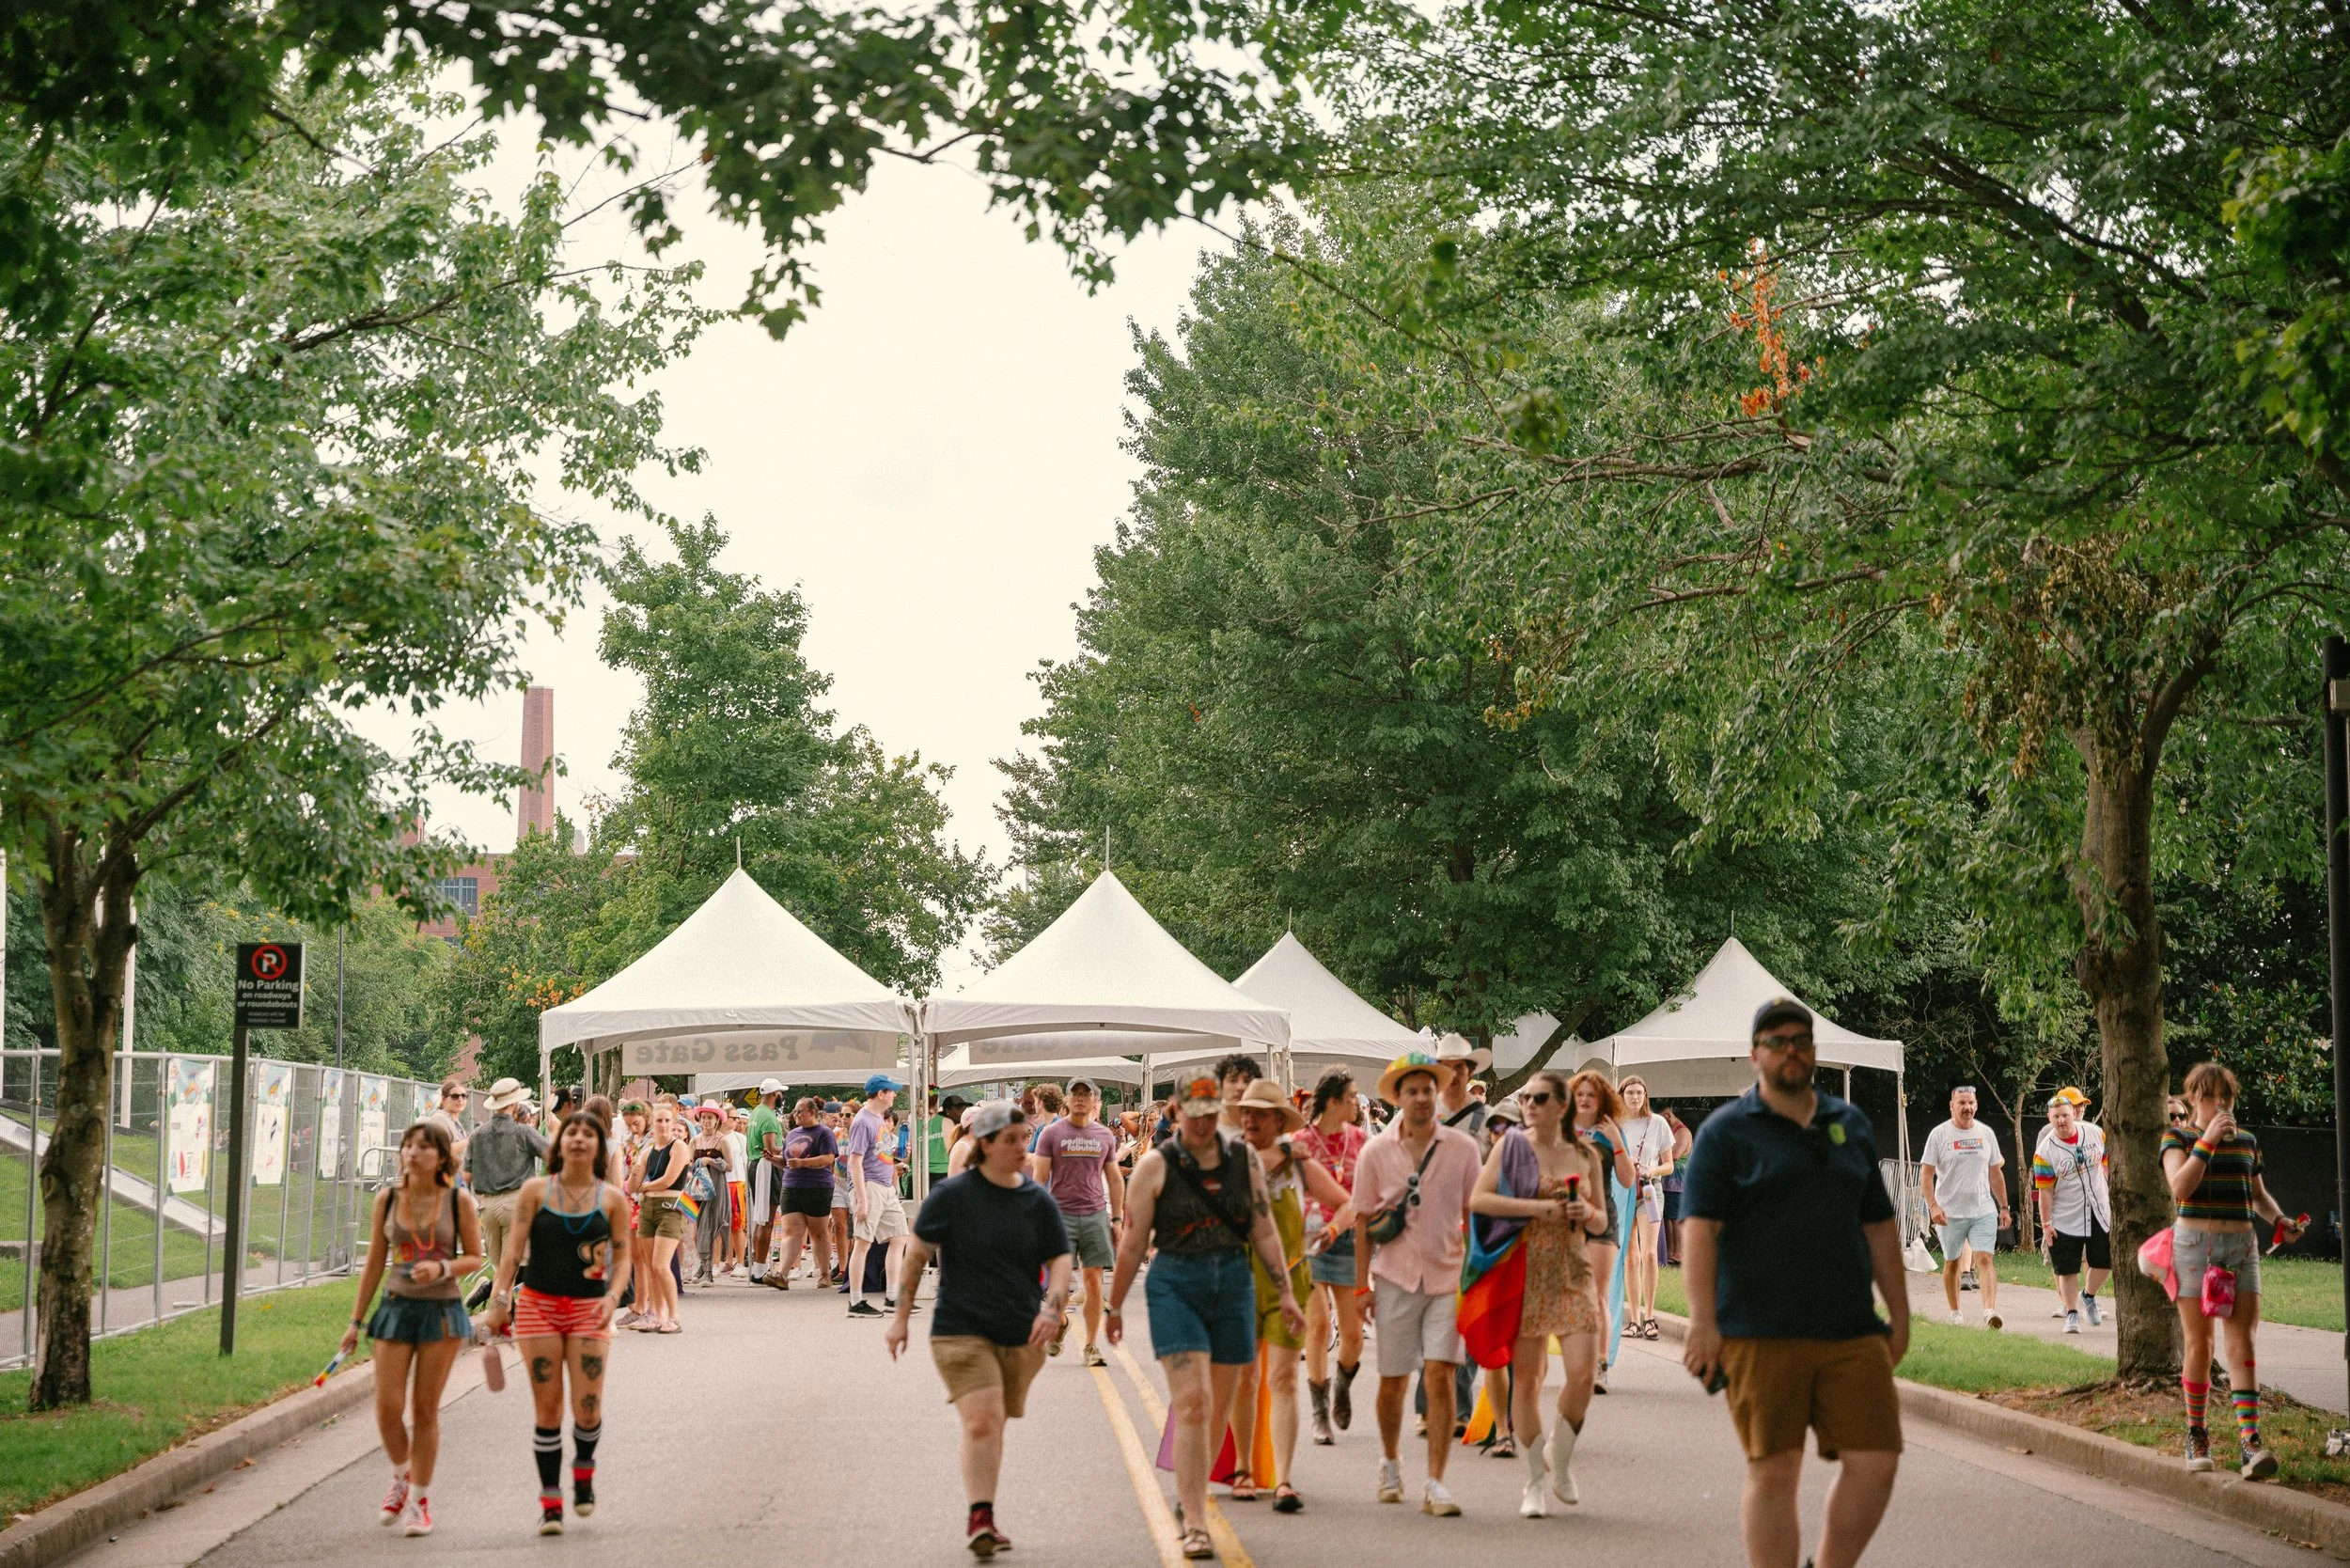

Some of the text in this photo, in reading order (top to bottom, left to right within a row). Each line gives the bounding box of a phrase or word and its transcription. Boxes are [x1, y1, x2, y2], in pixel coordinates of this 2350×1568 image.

[237, 980, 300, 993] No Parking
[254, 992, 291, 1000] roadways
[2083, 1142, 2097, 1152] TEAM
